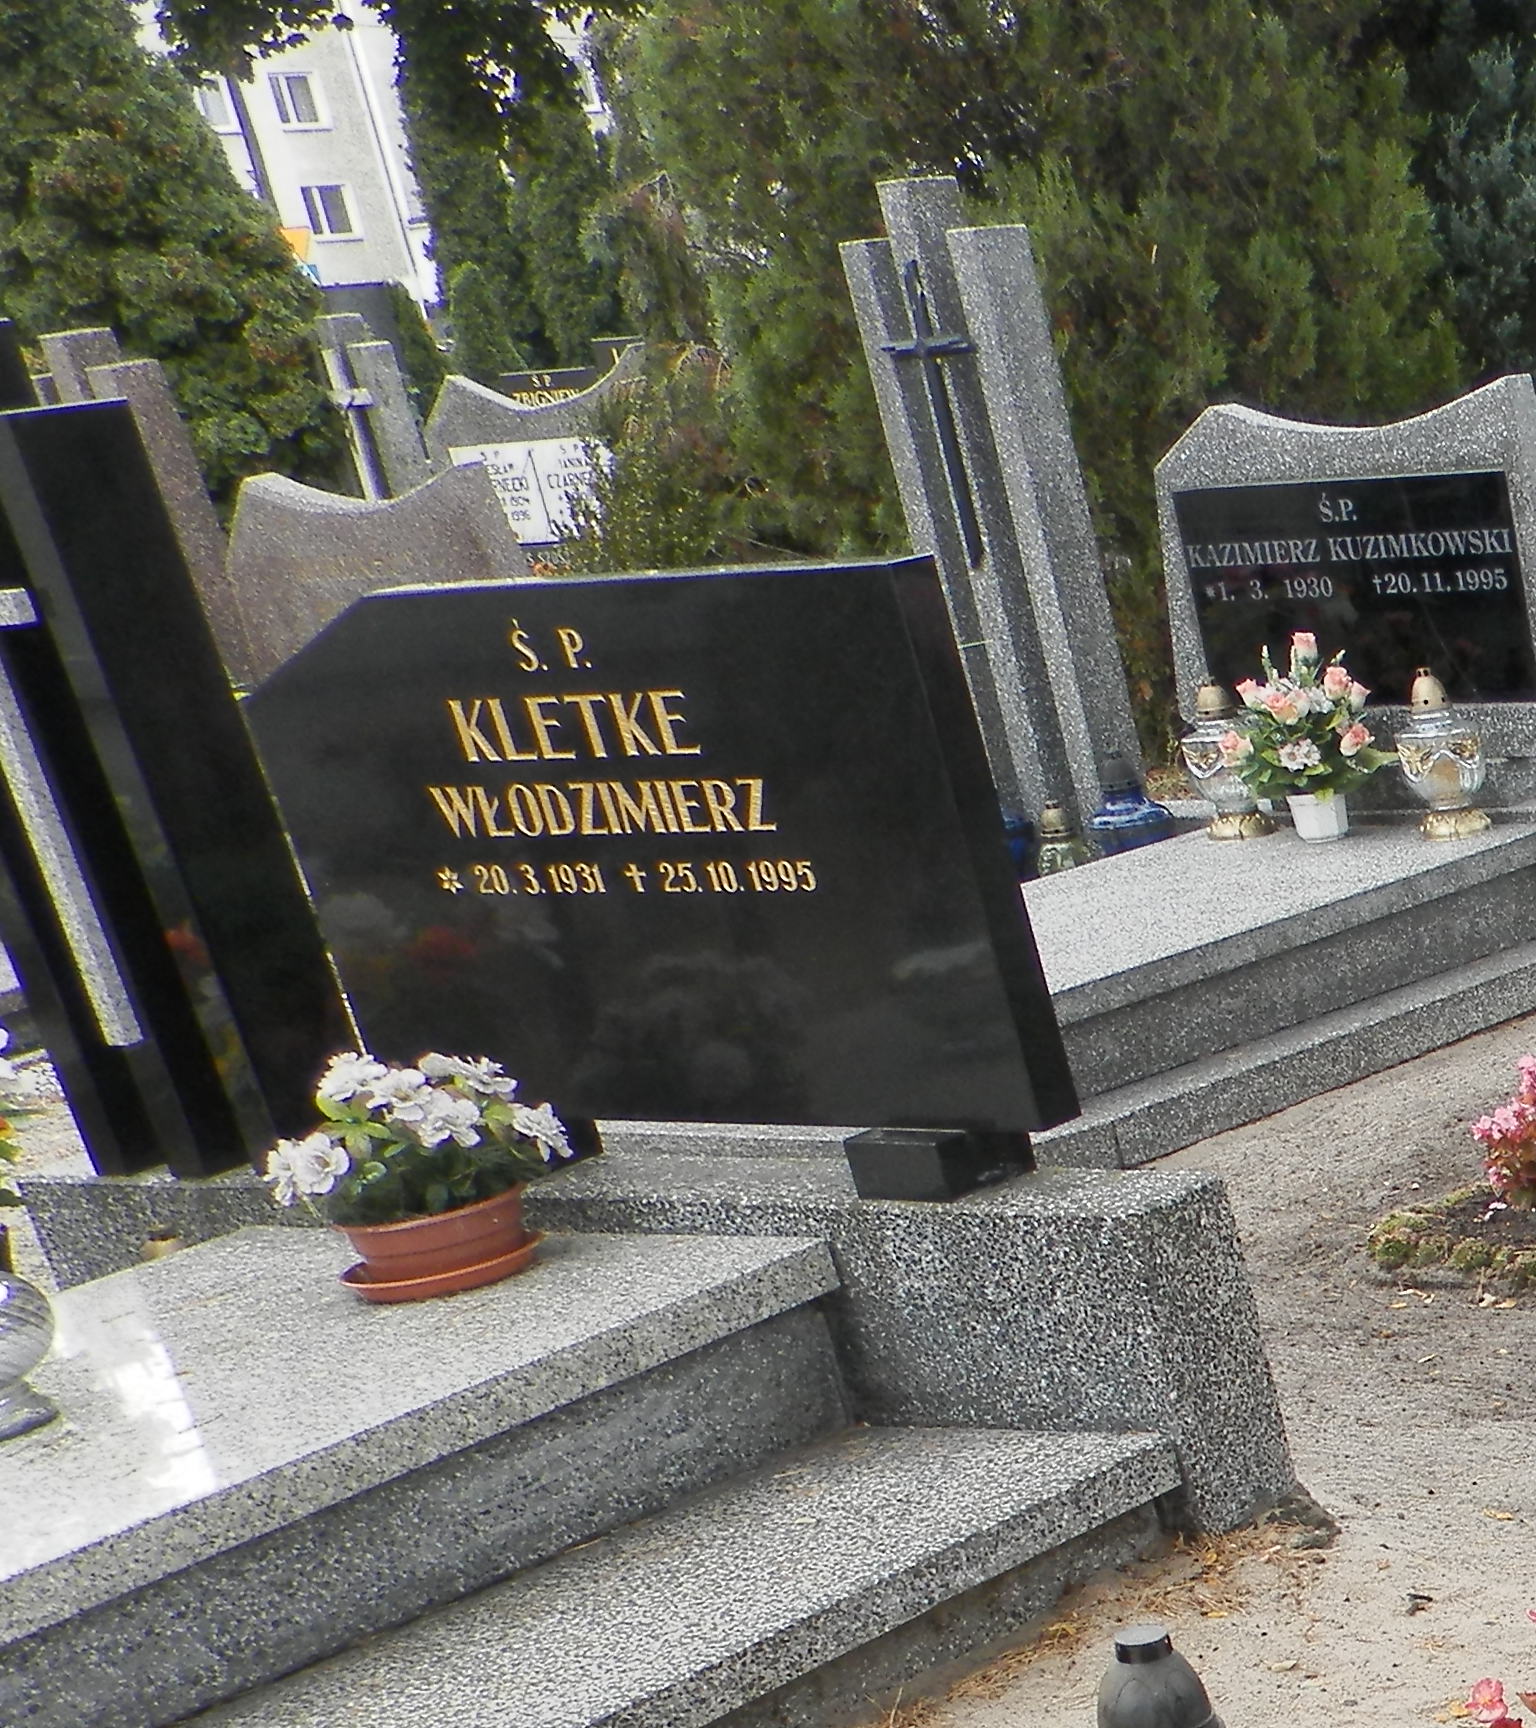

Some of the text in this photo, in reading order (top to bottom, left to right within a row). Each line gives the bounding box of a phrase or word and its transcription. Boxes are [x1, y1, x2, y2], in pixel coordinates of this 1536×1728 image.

[1187, 528, 1513, 569] KAZIMIERZ KUZIMKOWSKI
[447, 689, 703, 764] KLETKE
[427, 777, 778, 839] WŁODZIMIERZ
